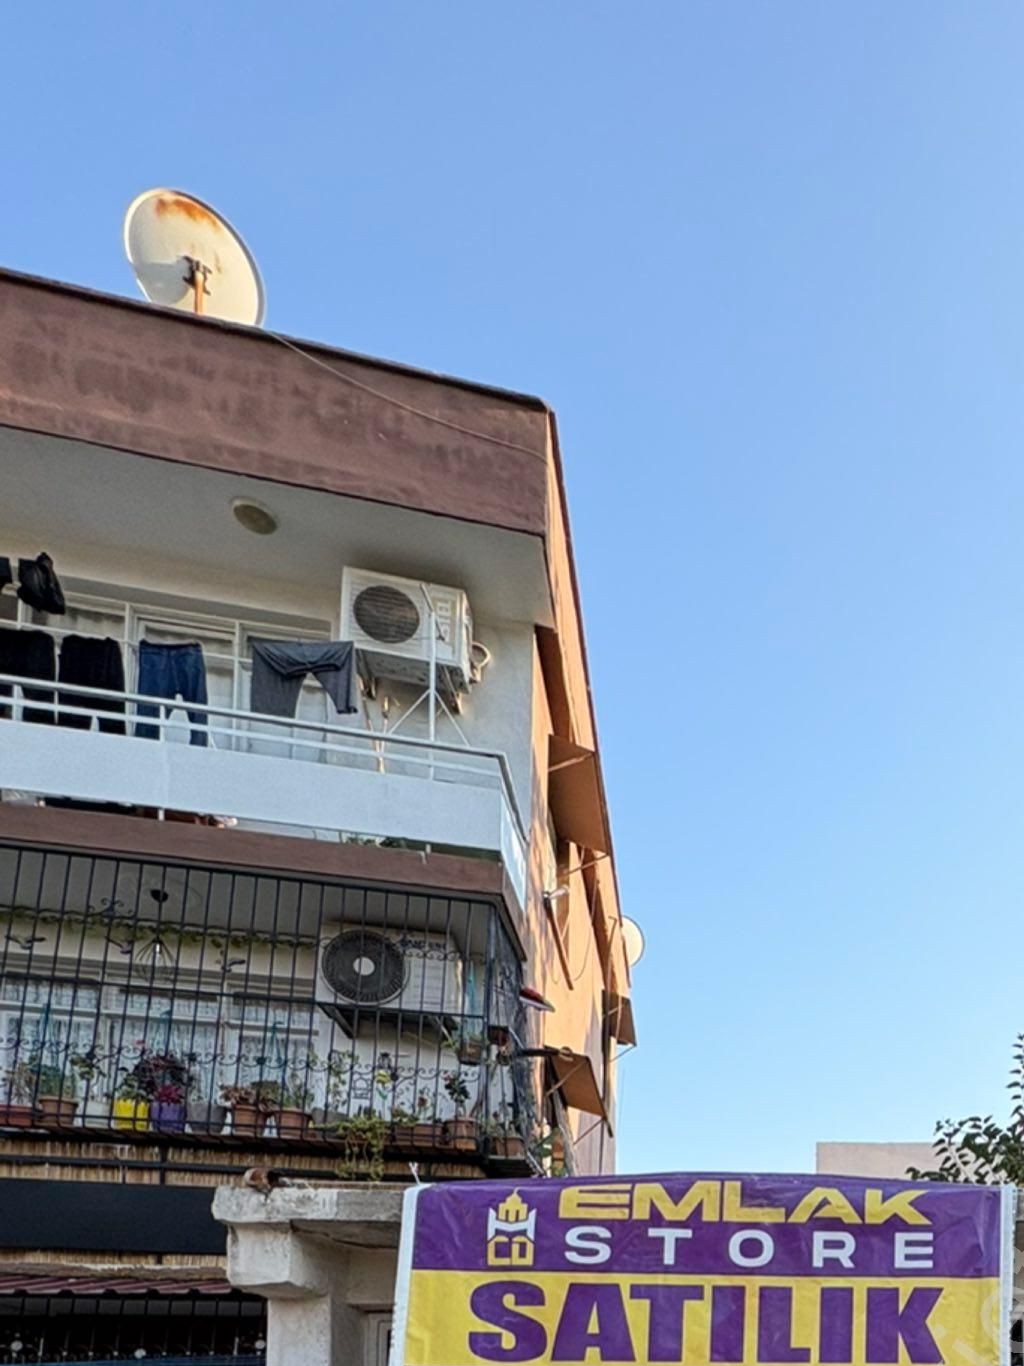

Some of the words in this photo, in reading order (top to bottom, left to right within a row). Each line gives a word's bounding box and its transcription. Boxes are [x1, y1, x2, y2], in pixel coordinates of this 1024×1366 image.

[558, 1180, 933, 1226] EMLAK
[564, 1225, 935, 1269] STORE
[468, 1281, 946, 1365] SATILIK
